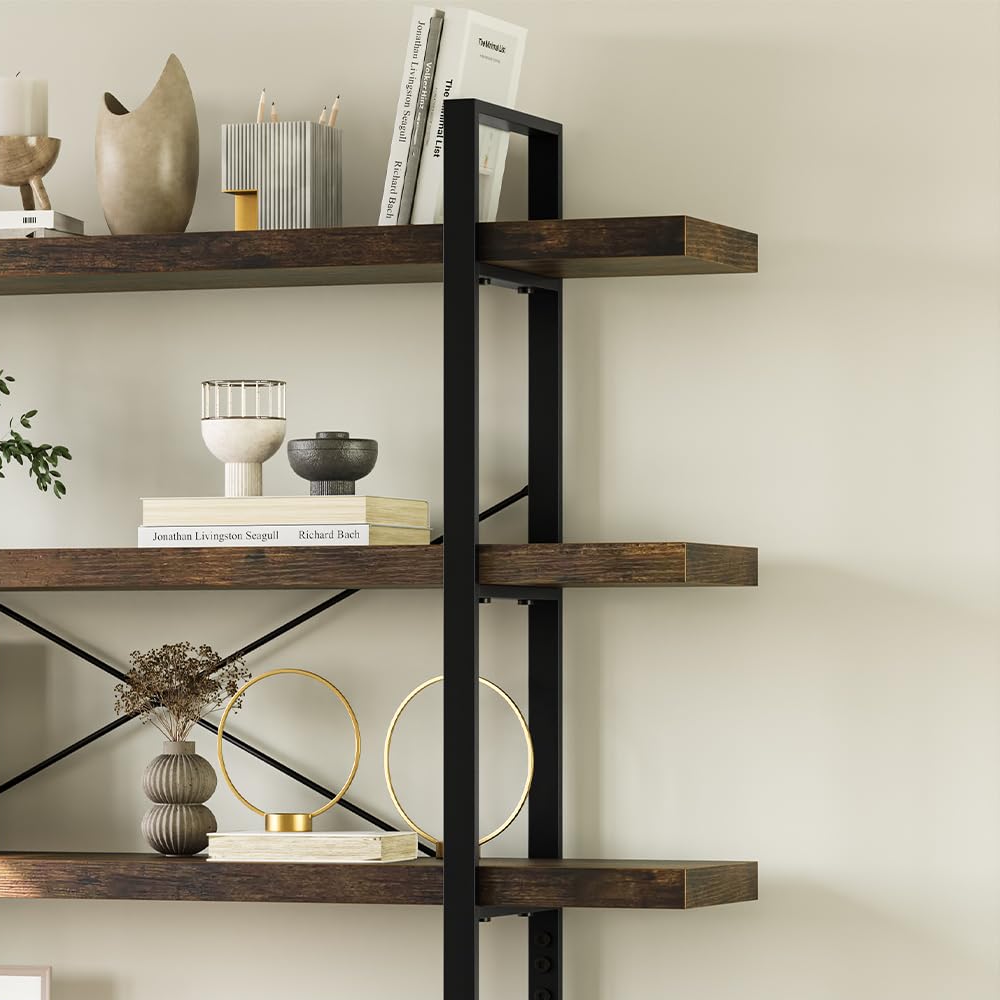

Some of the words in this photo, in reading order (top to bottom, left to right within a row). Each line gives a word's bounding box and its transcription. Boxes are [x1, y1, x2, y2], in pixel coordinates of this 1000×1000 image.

[412, 20, 426, 59] Jonathan
[404, 61, 417, 109] Livingston
[443, 79, 453, 97] The
[398, 110, 410, 142] Seagull
[433, 140, 442, 158] List
[390, 160, 402, 195] Richard
[386, 196, 397, 219] Bach
[153, 531, 192, 542] Jonathan
[195, 530, 243, 542] Livingston
[246, 530, 279, 542] Seagull
[298, 530, 334, 540] Richard
[337, 530, 360, 539] Bach
